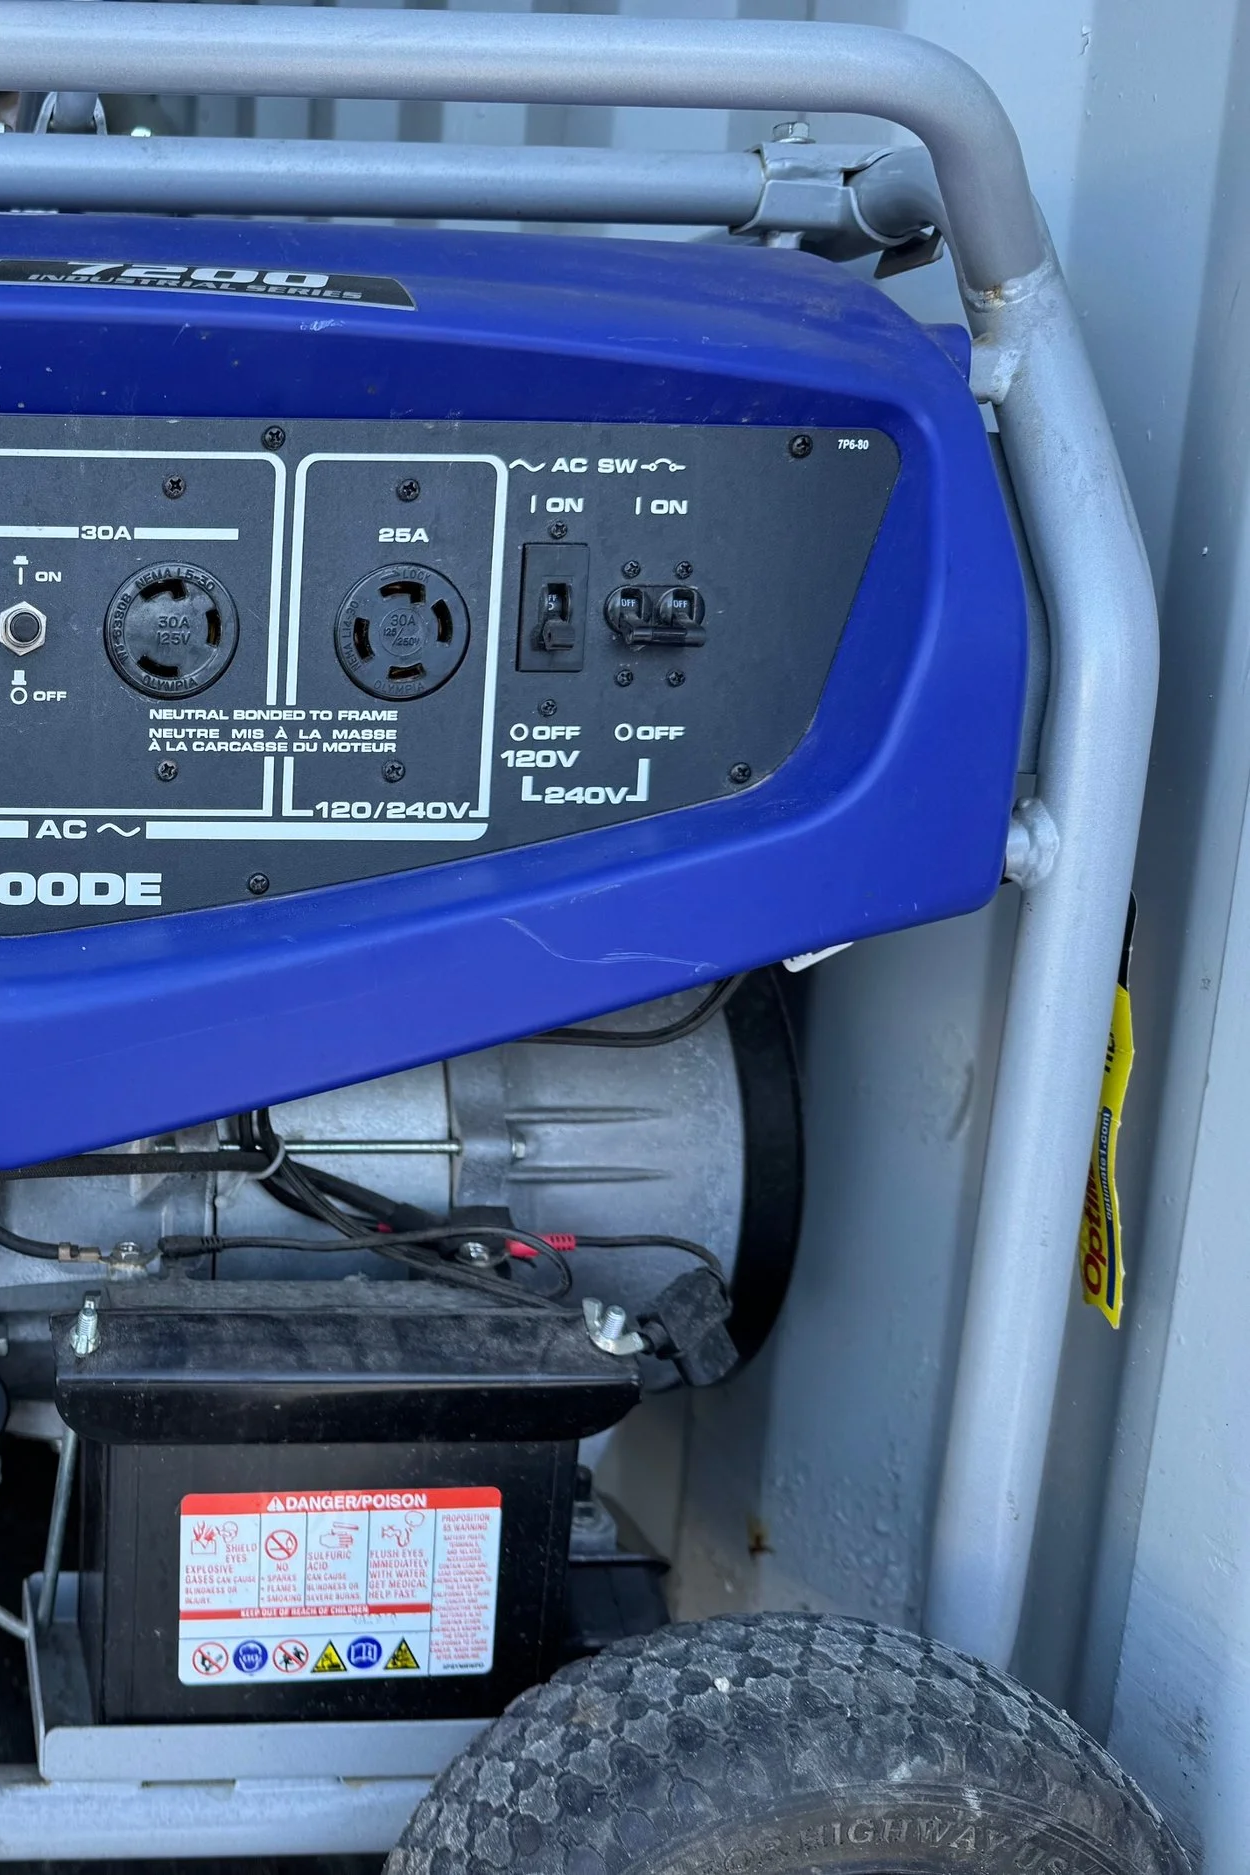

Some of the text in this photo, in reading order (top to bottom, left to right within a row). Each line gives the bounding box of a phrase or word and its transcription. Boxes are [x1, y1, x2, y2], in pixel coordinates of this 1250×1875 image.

[66, 262, 329, 288] 7200
[27, 272, 363, 300] INDUSTRIAL SERIES
[837, 439, 869, 450] 7P6-80
[550, 457, 639, 474] AC SW
[545, 496, 585, 513] ON
[650, 499, 688, 515] ON
[80, 525, 132, 541] 30A
[378, 527, 430, 543] 25A
[34, 570, 62, 583] ON
[402, 570, 431, 582] LOCK
[620, 598, 636, 608] OFF
[673, 599, 688, 609] OFF
[158, 616, 191, 629] 30A
[390, 614, 416, 627] 30A
[32, 690, 68, 702] OFF
[149, 709, 398, 721] NEUTRAL BONDED TO FRAME
[148, 726, 398, 740] NEUTRE MIS À LA MASSE
[532, 725, 582, 741] OFF
[636, 725, 685, 741] OFF
[148, 738, 397, 753] À LA CARCASSE DU MOTEUR
[500, 749, 581, 768] 120V
[544, 786, 629, 804] 240V
[315, 801, 470, 819] 120/240V
[35, 819, 88, 840] AC
[285, 1493, 428, 1511] DANGER/POISON
[225, 1543, 258, 1553] SHIELD
[369, 1548, 424, 1559] FLUSH EYES
[225, 1554, 247, 1563] EYES
[307, 1550, 352, 1561] SULFURIC
[185, 1564, 234, 1575] EXPLOSIVE
[275, 1563, 289, 1572] NO
[307, 1561, 328, 1571] ACID
[369, 1559, 428, 1569] IMMEDIATELY
[185, 1574, 215, 1584] GASES
[369, 1569, 393, 1579] WITH
[369, 1579, 386, 1590] GET
[388, 1578, 427, 1589] MEDICAL
[368, 1589, 391, 1600] HELP
[798, 1815, 1010, 1855] HIGHWAY
